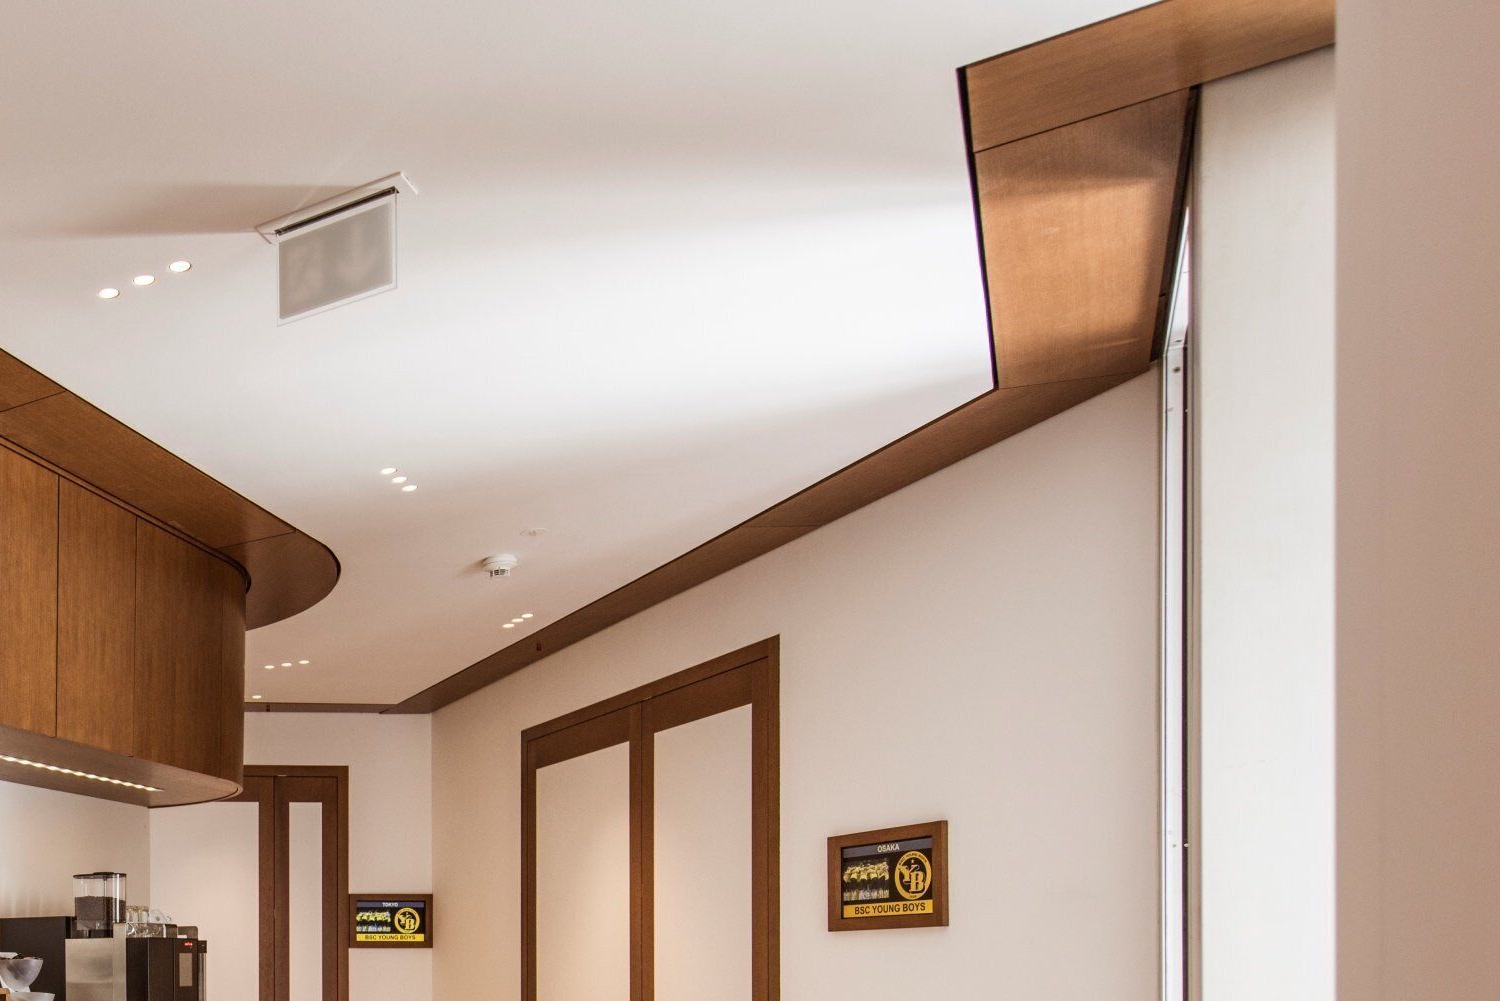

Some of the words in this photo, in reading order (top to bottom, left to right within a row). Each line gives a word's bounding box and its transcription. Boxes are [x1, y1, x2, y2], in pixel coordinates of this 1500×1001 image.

[877, 843, 900, 853] OSAKA
[854, 904, 870, 915] BSC
[872, 903, 901, 914] YOUNG
[903, 902, 926, 912] BOYS
